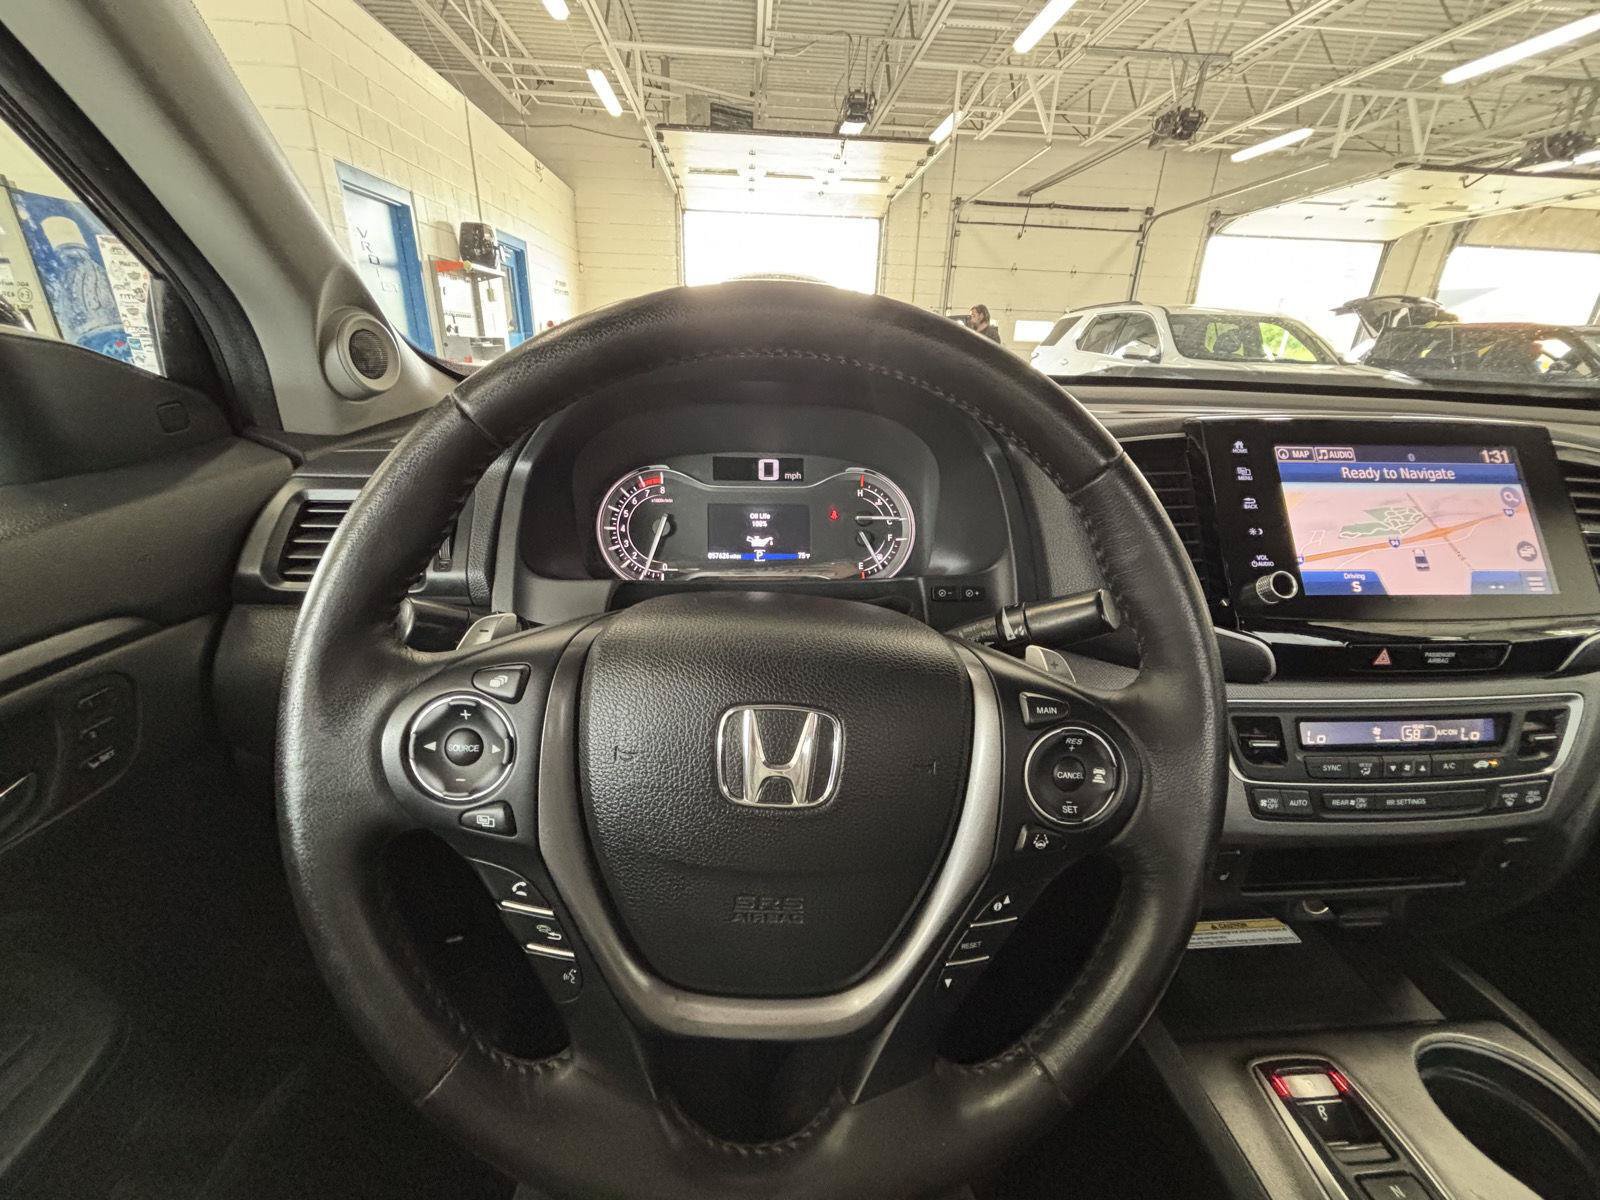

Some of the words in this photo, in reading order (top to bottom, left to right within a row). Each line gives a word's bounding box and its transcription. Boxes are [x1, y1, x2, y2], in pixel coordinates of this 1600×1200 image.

[1329, 451, 1353, 459] AUDIO
[758, 459, 779, 480] 0
[784, 472, 802, 480] mph
[1341, 467, 1380, 481] Ready
[1384, 468, 1397, 479] to
[1400, 468, 1456, 481] Navigate
[645, 489, 650, 497] 7
[857, 489, 864, 497] H
[662, 563, 668, 571] 0
[858, 562, 864, 570] E
[1351, 581, 1362, 592] S
[1036, 706, 1058, 714] MAIN
[448, 744, 480, 752] SOURCE
[1057, 771, 1084, 779] CANCEL
[961, 941, 982, 949] RESET
[1317, 1105, 1327, 1118] R
